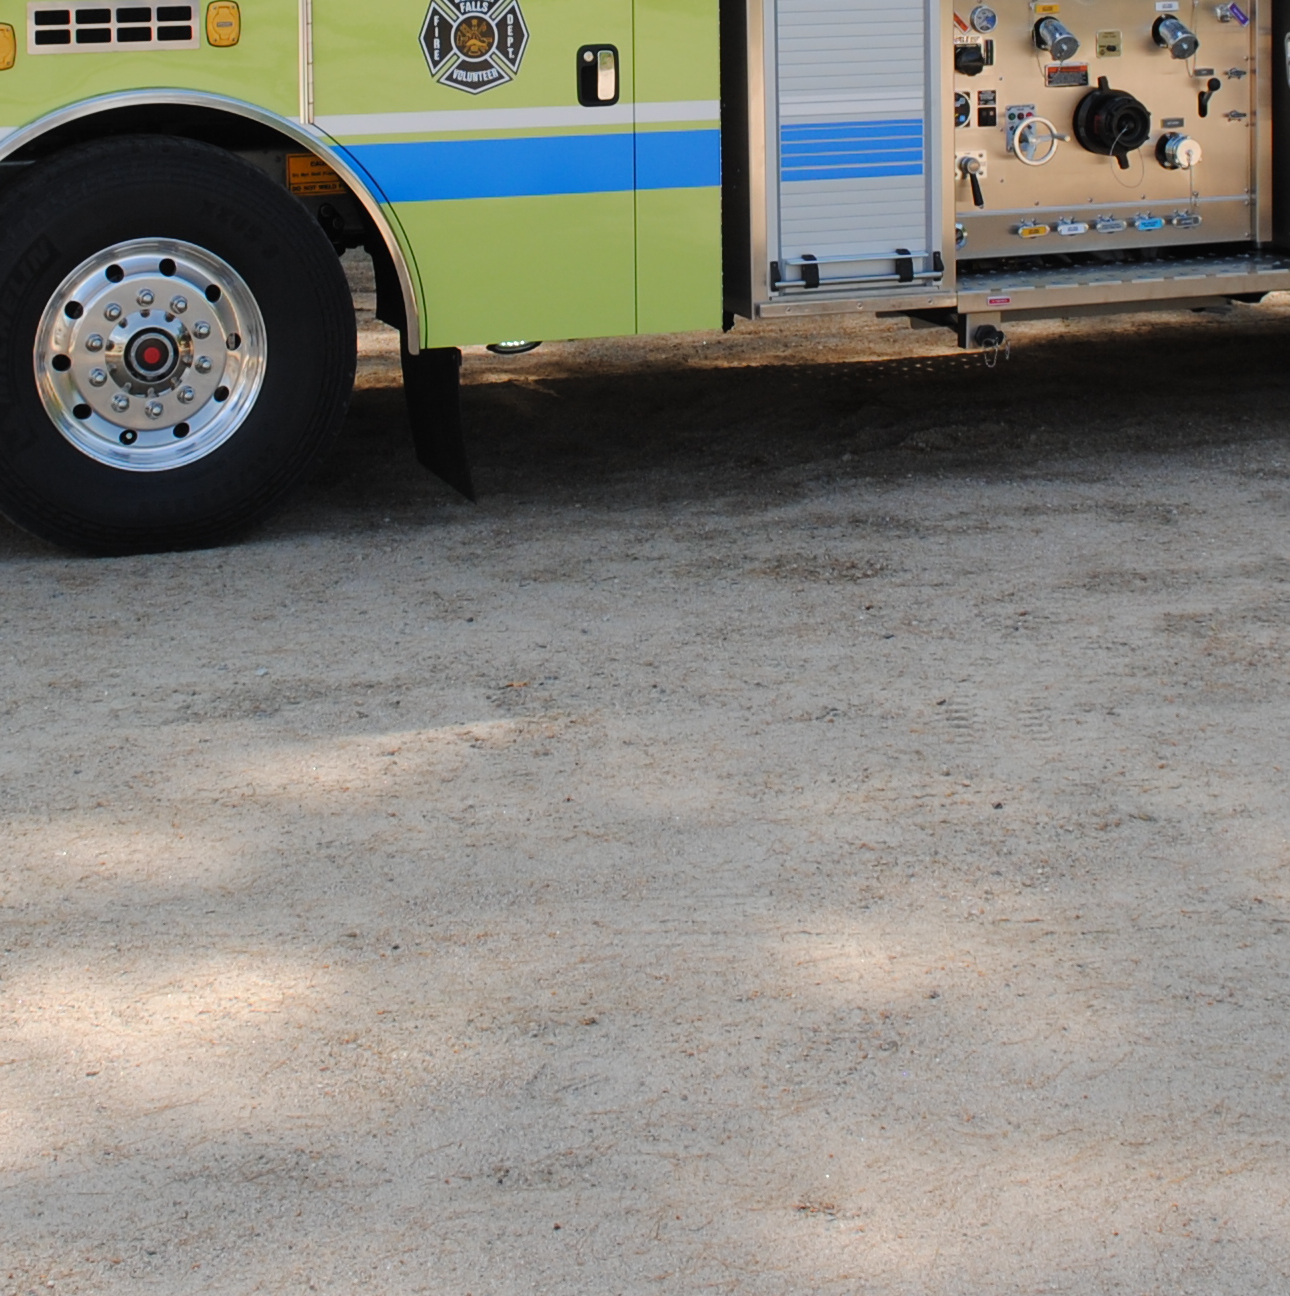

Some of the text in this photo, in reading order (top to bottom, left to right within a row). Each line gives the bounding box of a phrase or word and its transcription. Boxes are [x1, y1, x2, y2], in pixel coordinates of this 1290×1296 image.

[459, 0, 489, 13] FALLS
[506, 13, 515, 59] DEPT.
[452, 68, 499, 83] VOLUNTEER
